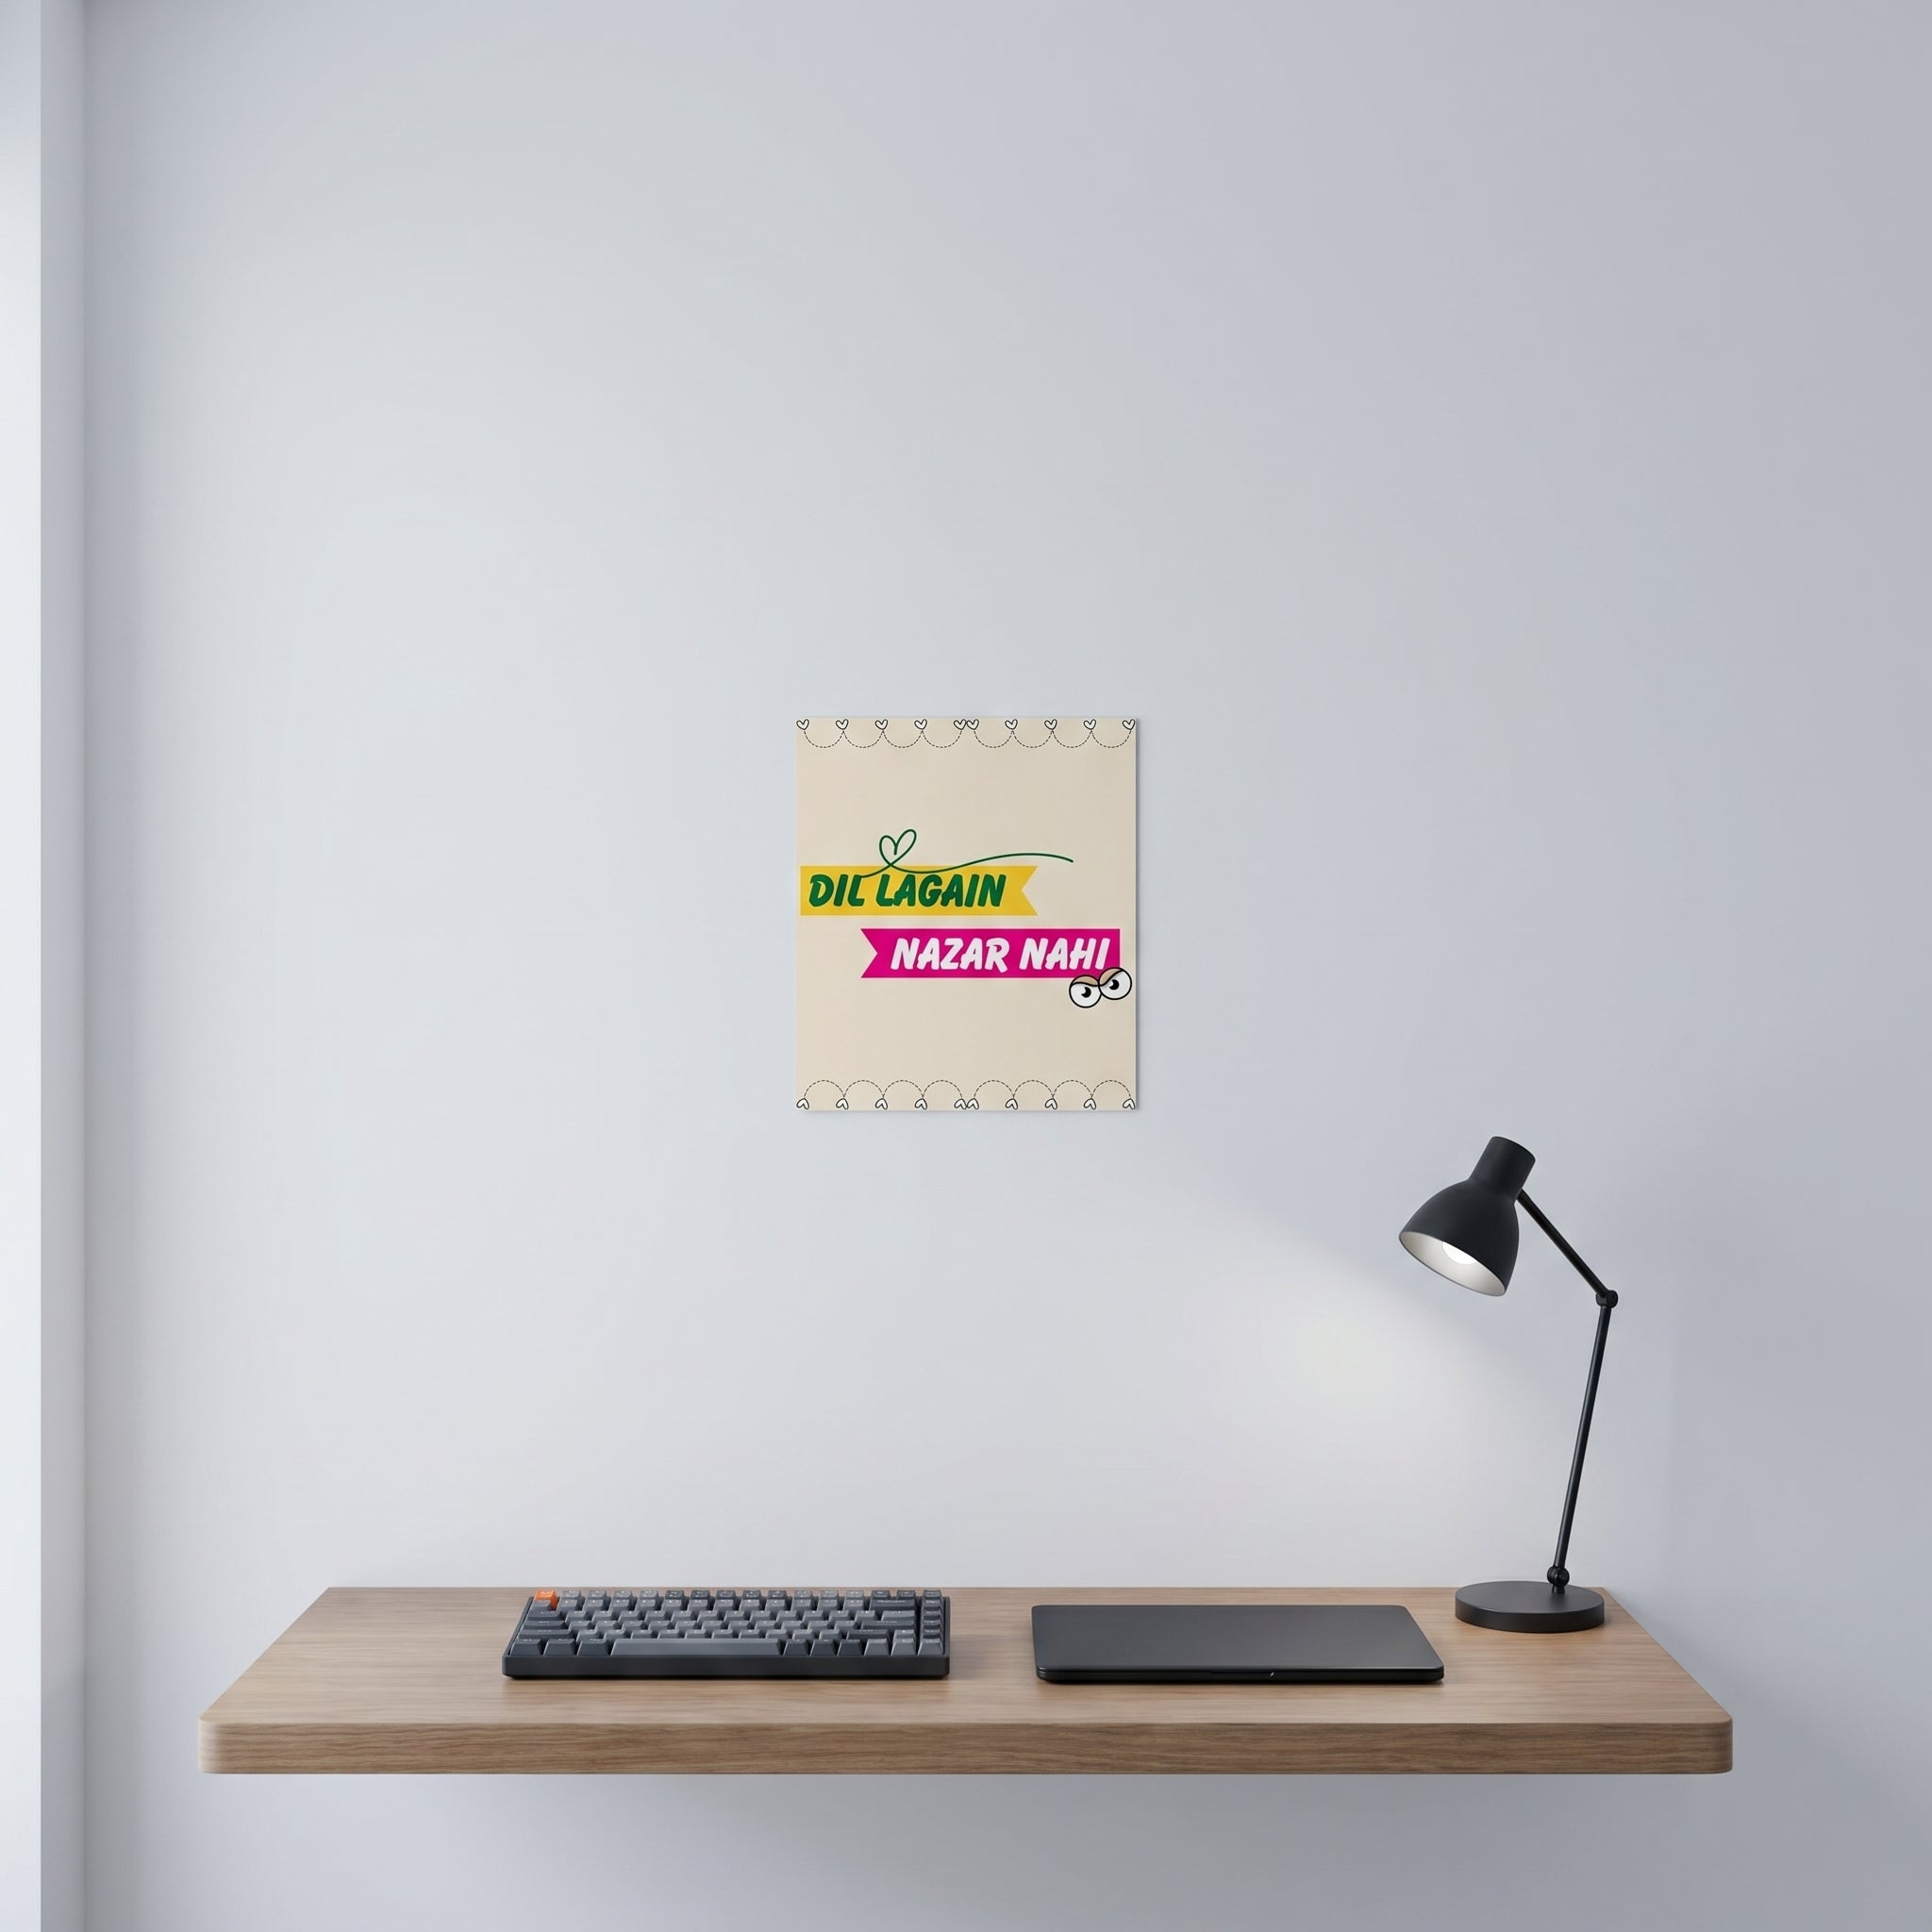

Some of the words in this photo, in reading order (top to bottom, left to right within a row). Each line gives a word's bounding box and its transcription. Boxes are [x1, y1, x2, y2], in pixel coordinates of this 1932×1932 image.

[808, 874, 865, 908] DIL
[875, 874, 1007, 908] LAGAIN
[891, 938, 1010, 974] NAZAR
[1019, 938, 1111, 971] NAHI
